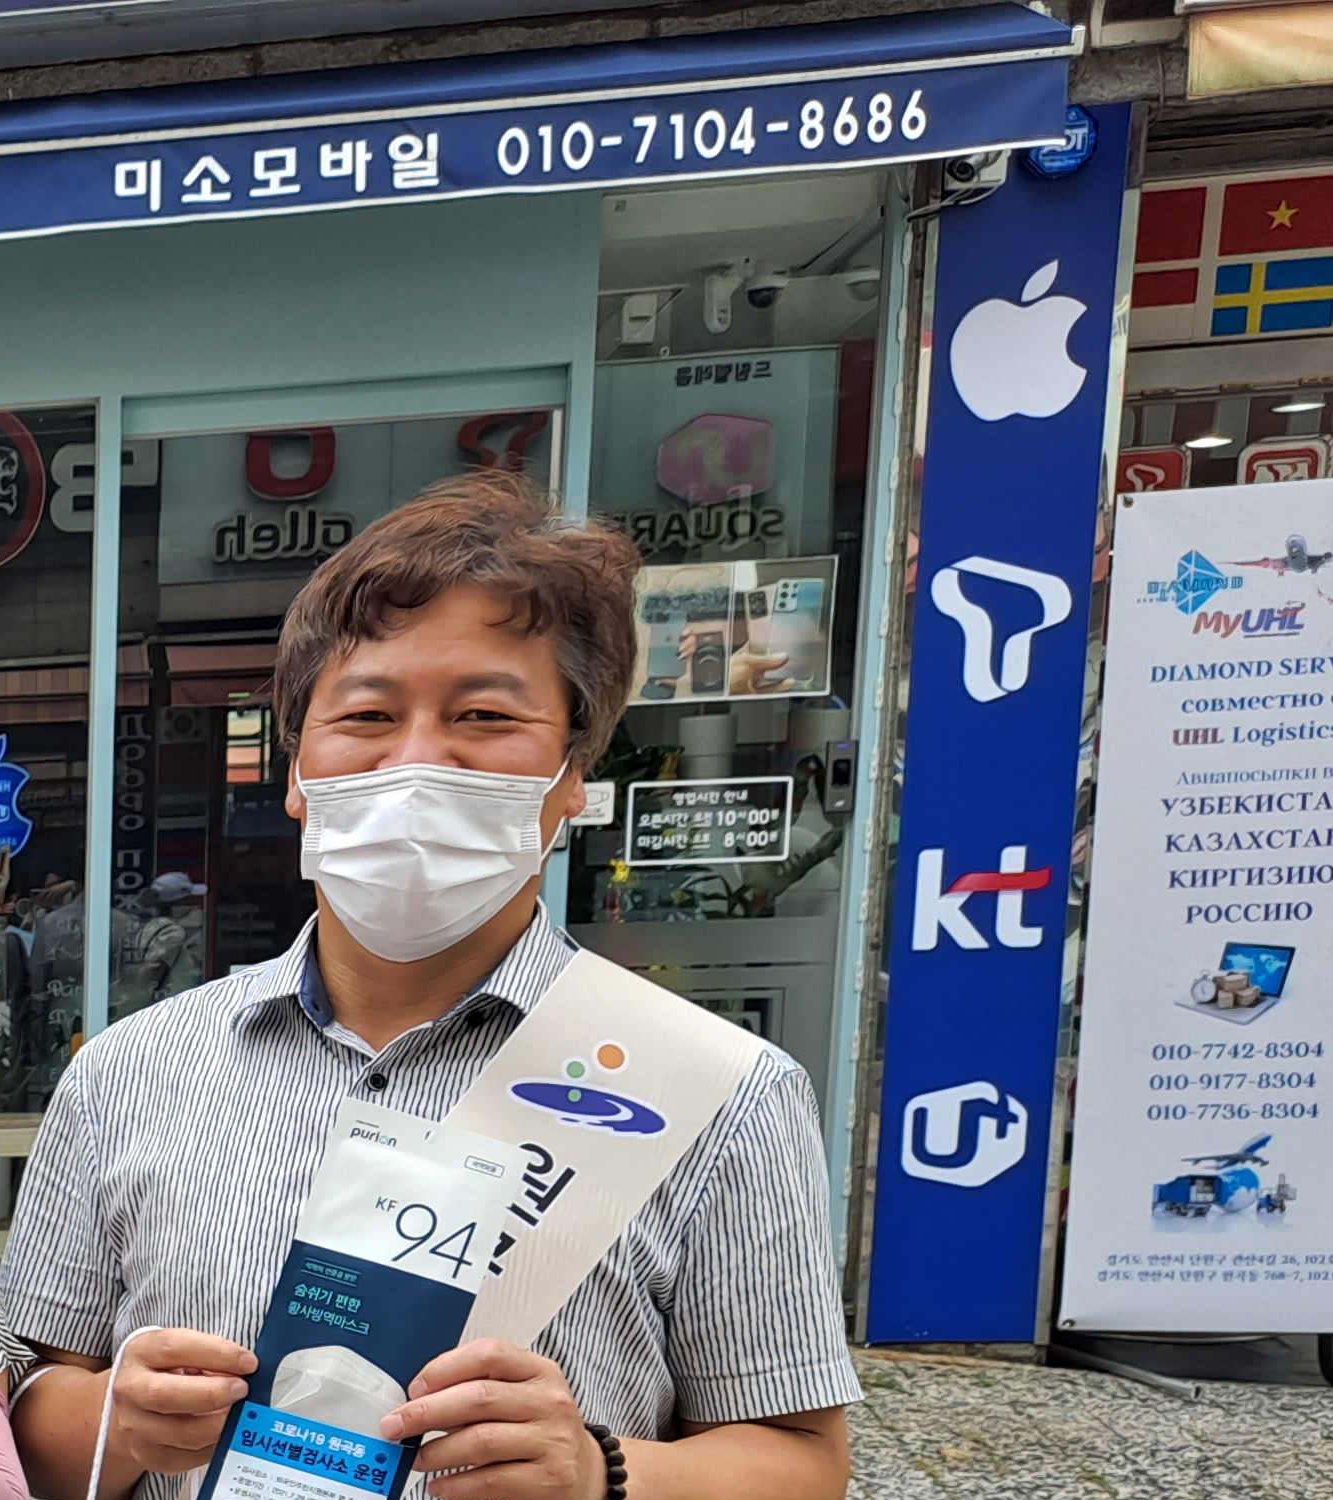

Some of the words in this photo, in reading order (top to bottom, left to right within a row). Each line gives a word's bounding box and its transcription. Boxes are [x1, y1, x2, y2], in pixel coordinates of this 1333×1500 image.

[113, 130, 442, 213] 미소모바일
[496, 89, 928, 178] 010-7104-8686
[1150, 660, 1273, 683] DIAMOND
[1181, 692, 1323, 714] совместно
[1172, 728, 1225, 746] UHL
[912, 845, 1051, 952] kt
[1185, 901, 1313, 925] РОССИЮ
[1152, 1040, 1325, 1062] 010-7742-8304
[1149, 1071, 1317, 1091] 010-9177-8304
[1147, 1101, 1320, 1122] 010-7736-8304
[293, 1283, 334, 1303] 숨쉬기
[335, 1293, 362, 1314] 편한
[271, 1420, 326, 1445] 코로나19
[328, 1435, 367, 1459] 원곡동
[241, 1429, 349, 1474] 임시선별검사소
[354, 1462, 388, 1487] 운영
